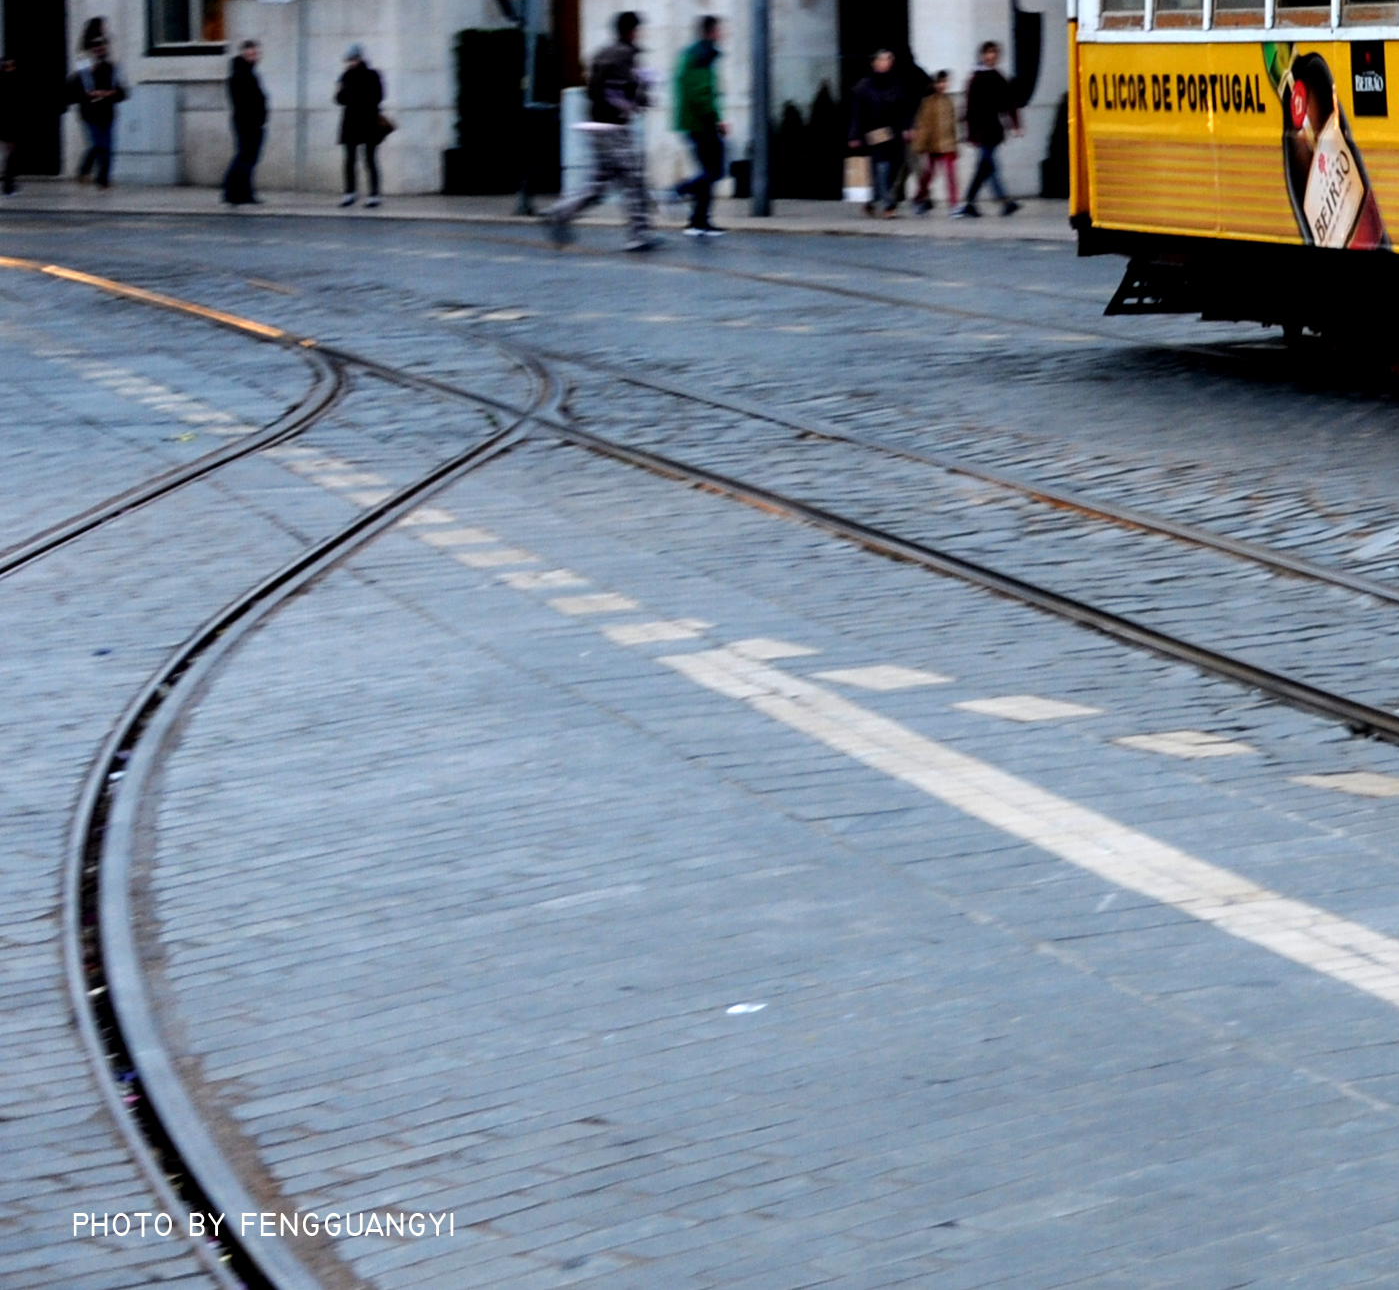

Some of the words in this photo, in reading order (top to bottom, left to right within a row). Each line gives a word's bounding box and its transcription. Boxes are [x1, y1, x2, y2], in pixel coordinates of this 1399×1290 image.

[1089, 73, 1099, 110] O
[1102, 73, 1148, 111] LICOR
[1151, 73, 1173, 111] DE
[1176, 73, 1267, 114] PORTUGAL
